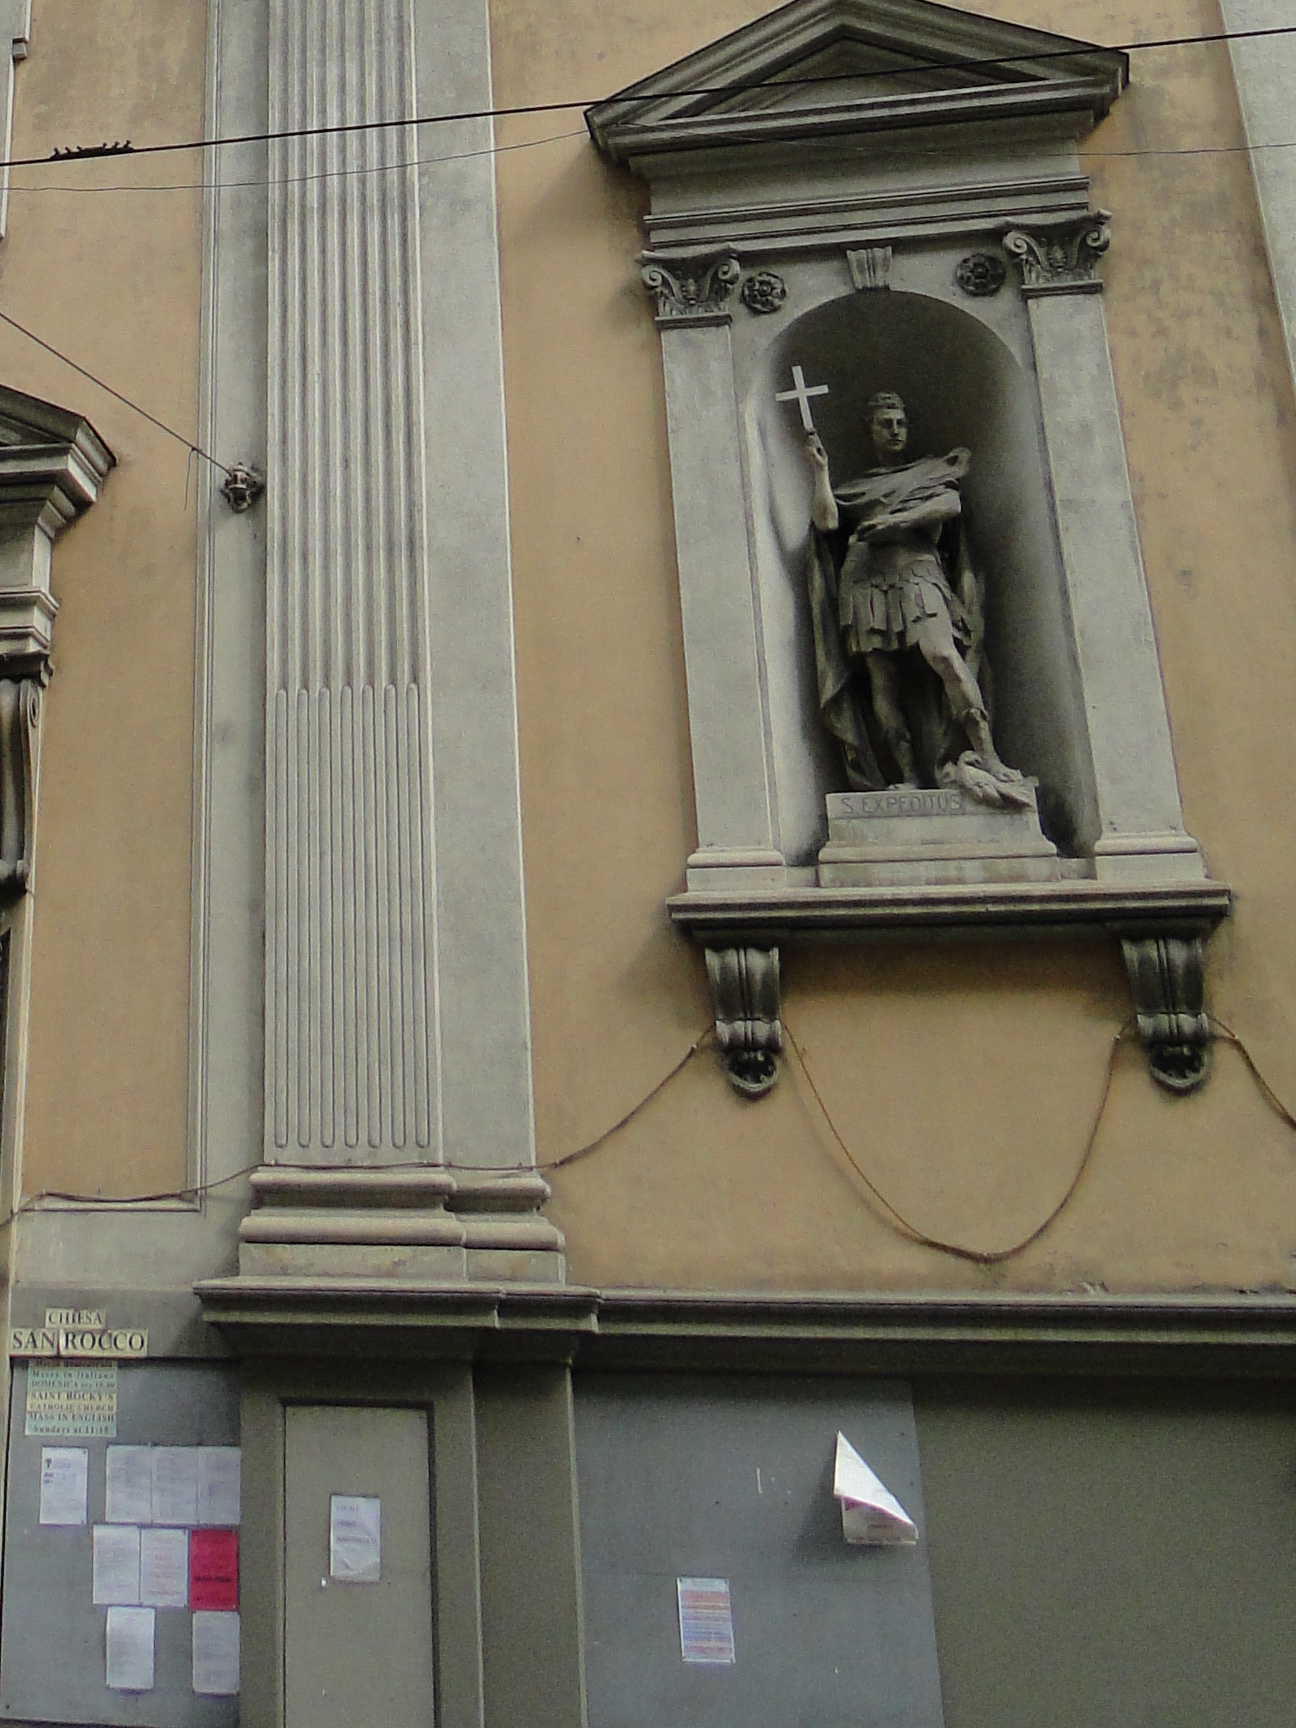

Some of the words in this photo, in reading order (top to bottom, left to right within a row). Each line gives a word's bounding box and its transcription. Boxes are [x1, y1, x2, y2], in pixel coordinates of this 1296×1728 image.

[48, 1311, 102, 1325] CHIESA
[13, 1331, 55, 1350] SAN
[65, 1332, 145, 1351] ROCCO
